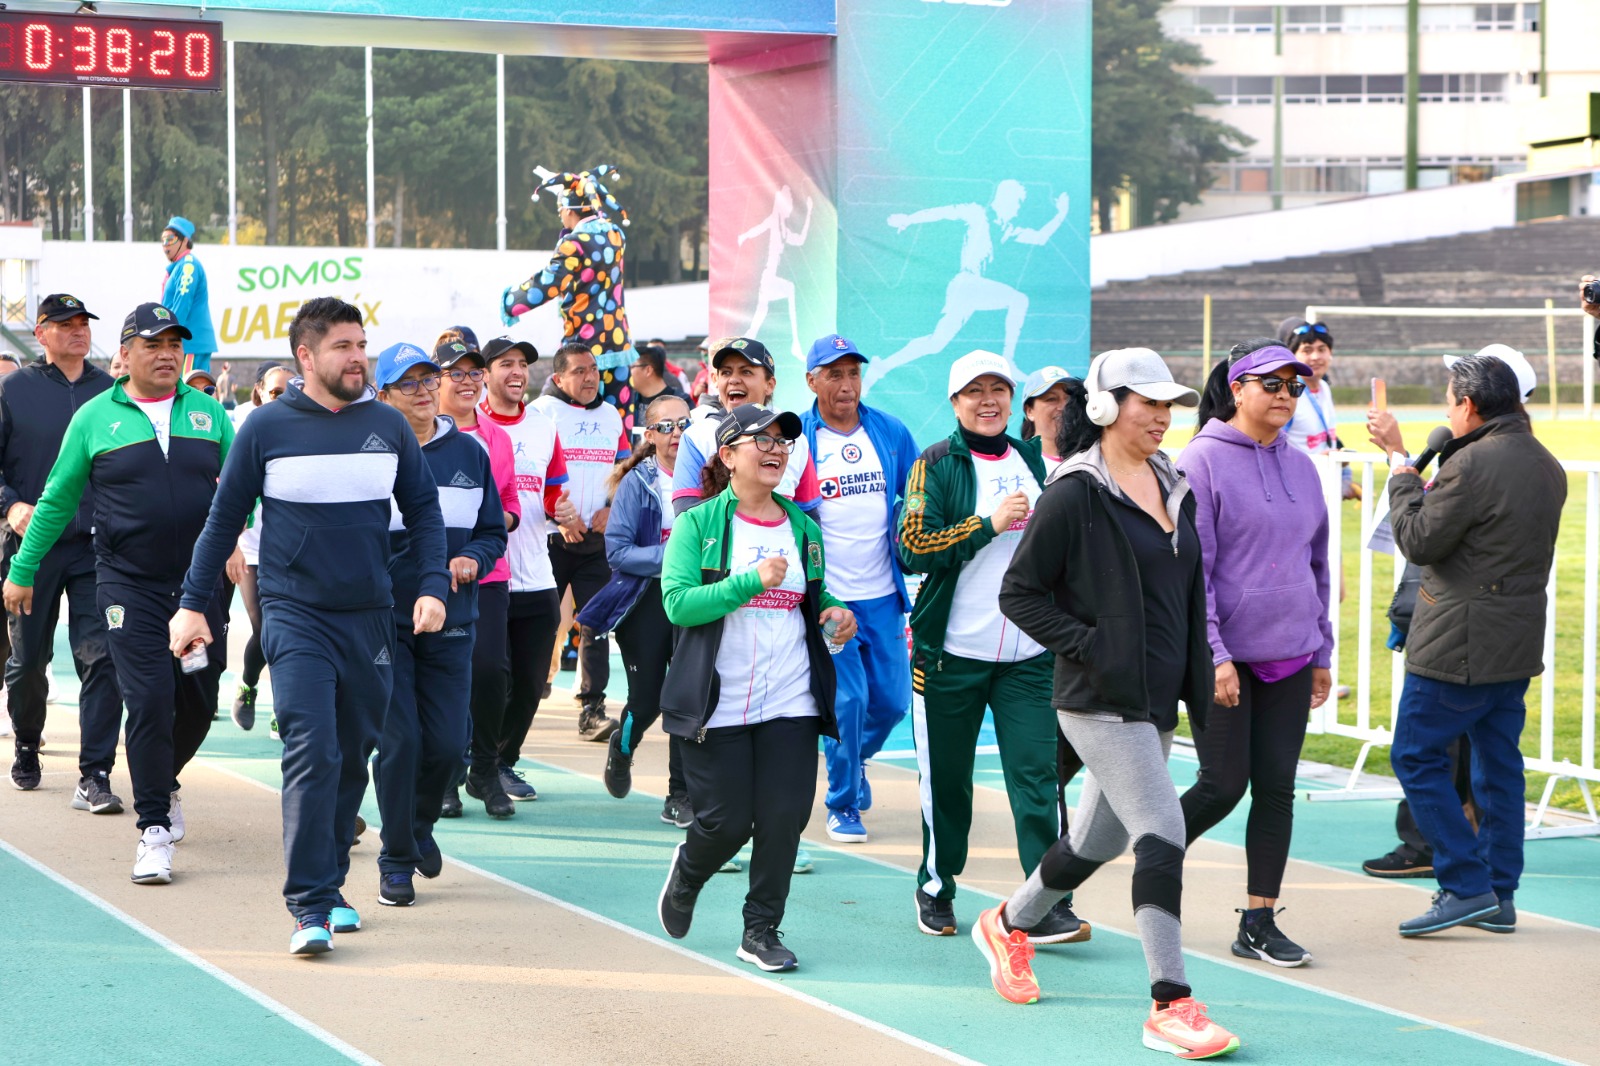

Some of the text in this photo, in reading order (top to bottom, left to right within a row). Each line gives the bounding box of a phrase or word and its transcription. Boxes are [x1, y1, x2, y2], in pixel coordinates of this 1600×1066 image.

[25, 23, 210, 77] 0:38:20
[237, 256, 363, 292] SOMOS
[841, 482, 886, 496] CRUZ AZU
[744, 610, 785, 619] 2025
